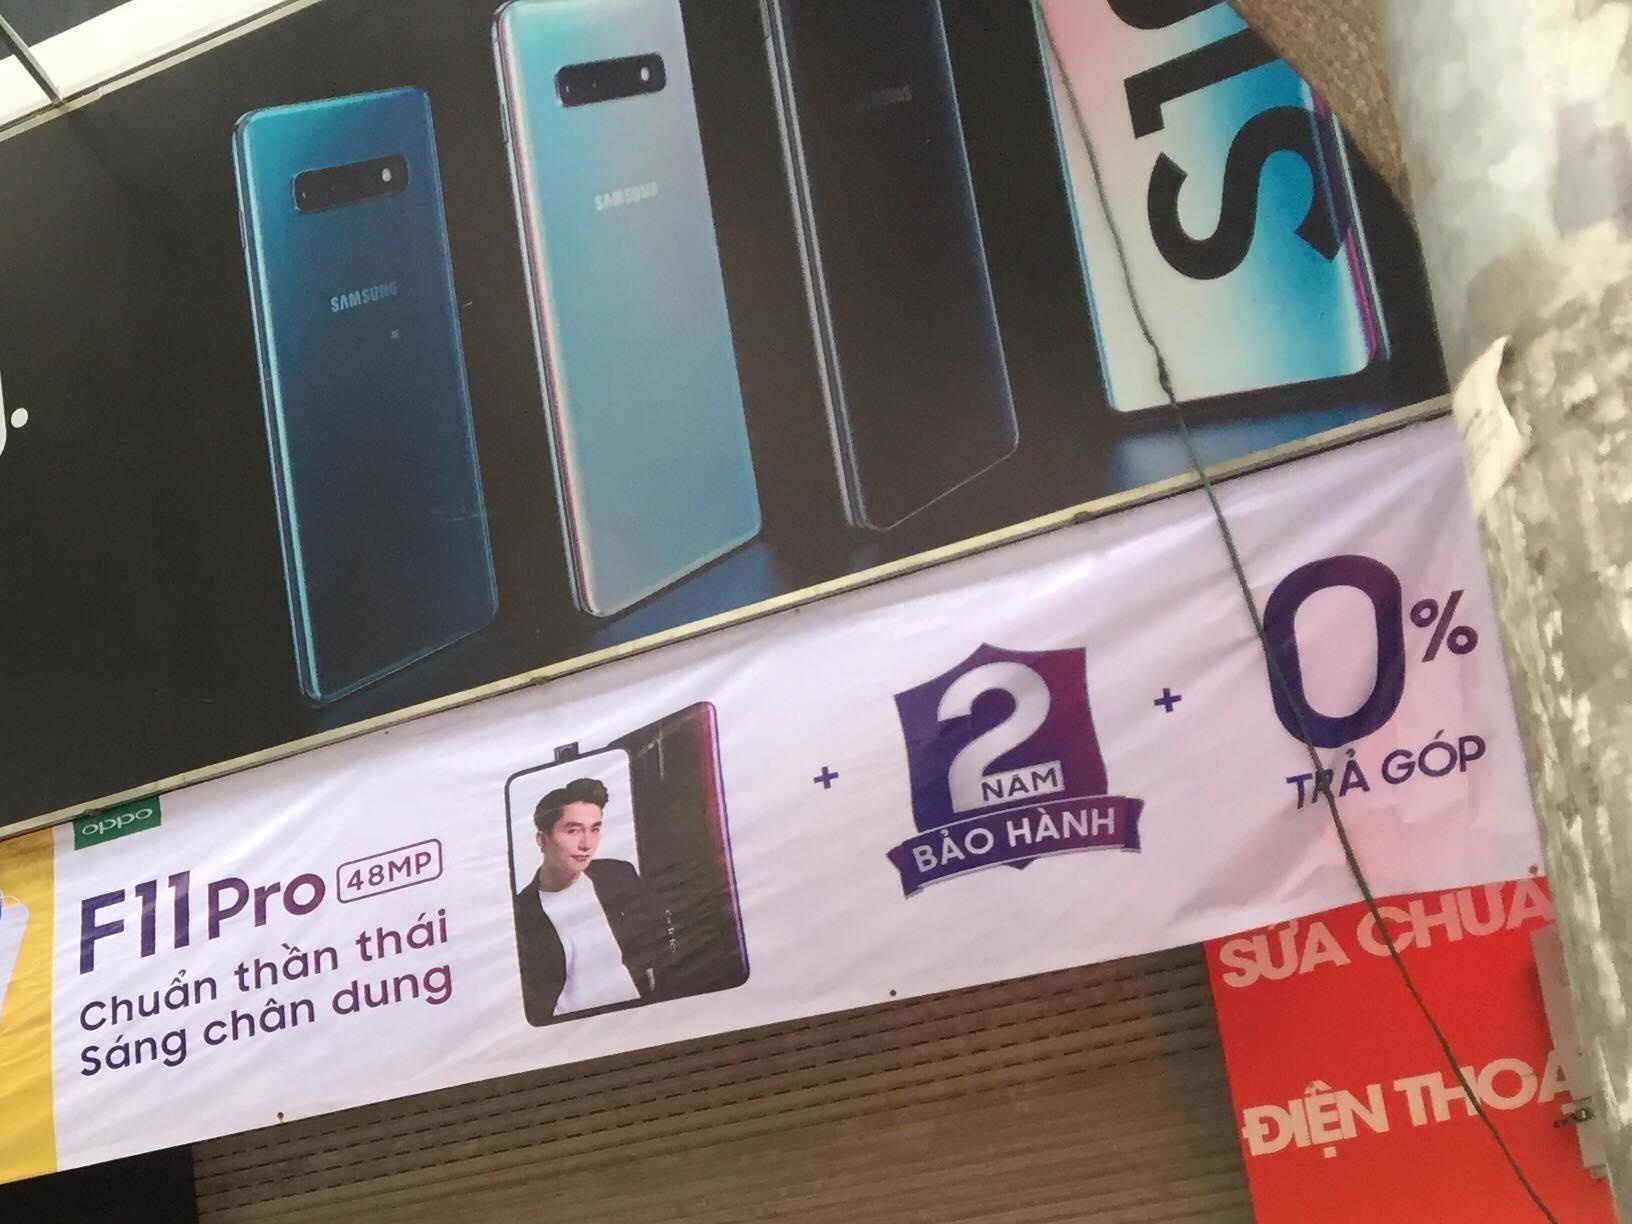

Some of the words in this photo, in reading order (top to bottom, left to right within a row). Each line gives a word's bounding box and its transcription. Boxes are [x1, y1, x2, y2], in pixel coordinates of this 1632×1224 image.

[329, 281, 398, 313] SAMSUNG
[936, 661, 1052, 814] 2
[1381, 729, 1486, 785] GÓP
[346, 850, 433, 892] 48MP
[911, 827, 995, 874] BẢO
[1006, 807, 1116, 848] HÀNH
[79, 968, 218, 1032] Chuẩn
[234, 942, 339, 993] thần
[355, 908, 450, 962] thái
[80, 1028, 188, 1077] Sáng
[203, 997, 316, 1046] chân
[332, 964, 454, 1017] dung
[1242, 1079, 1389, 1158] ĐIỆN
